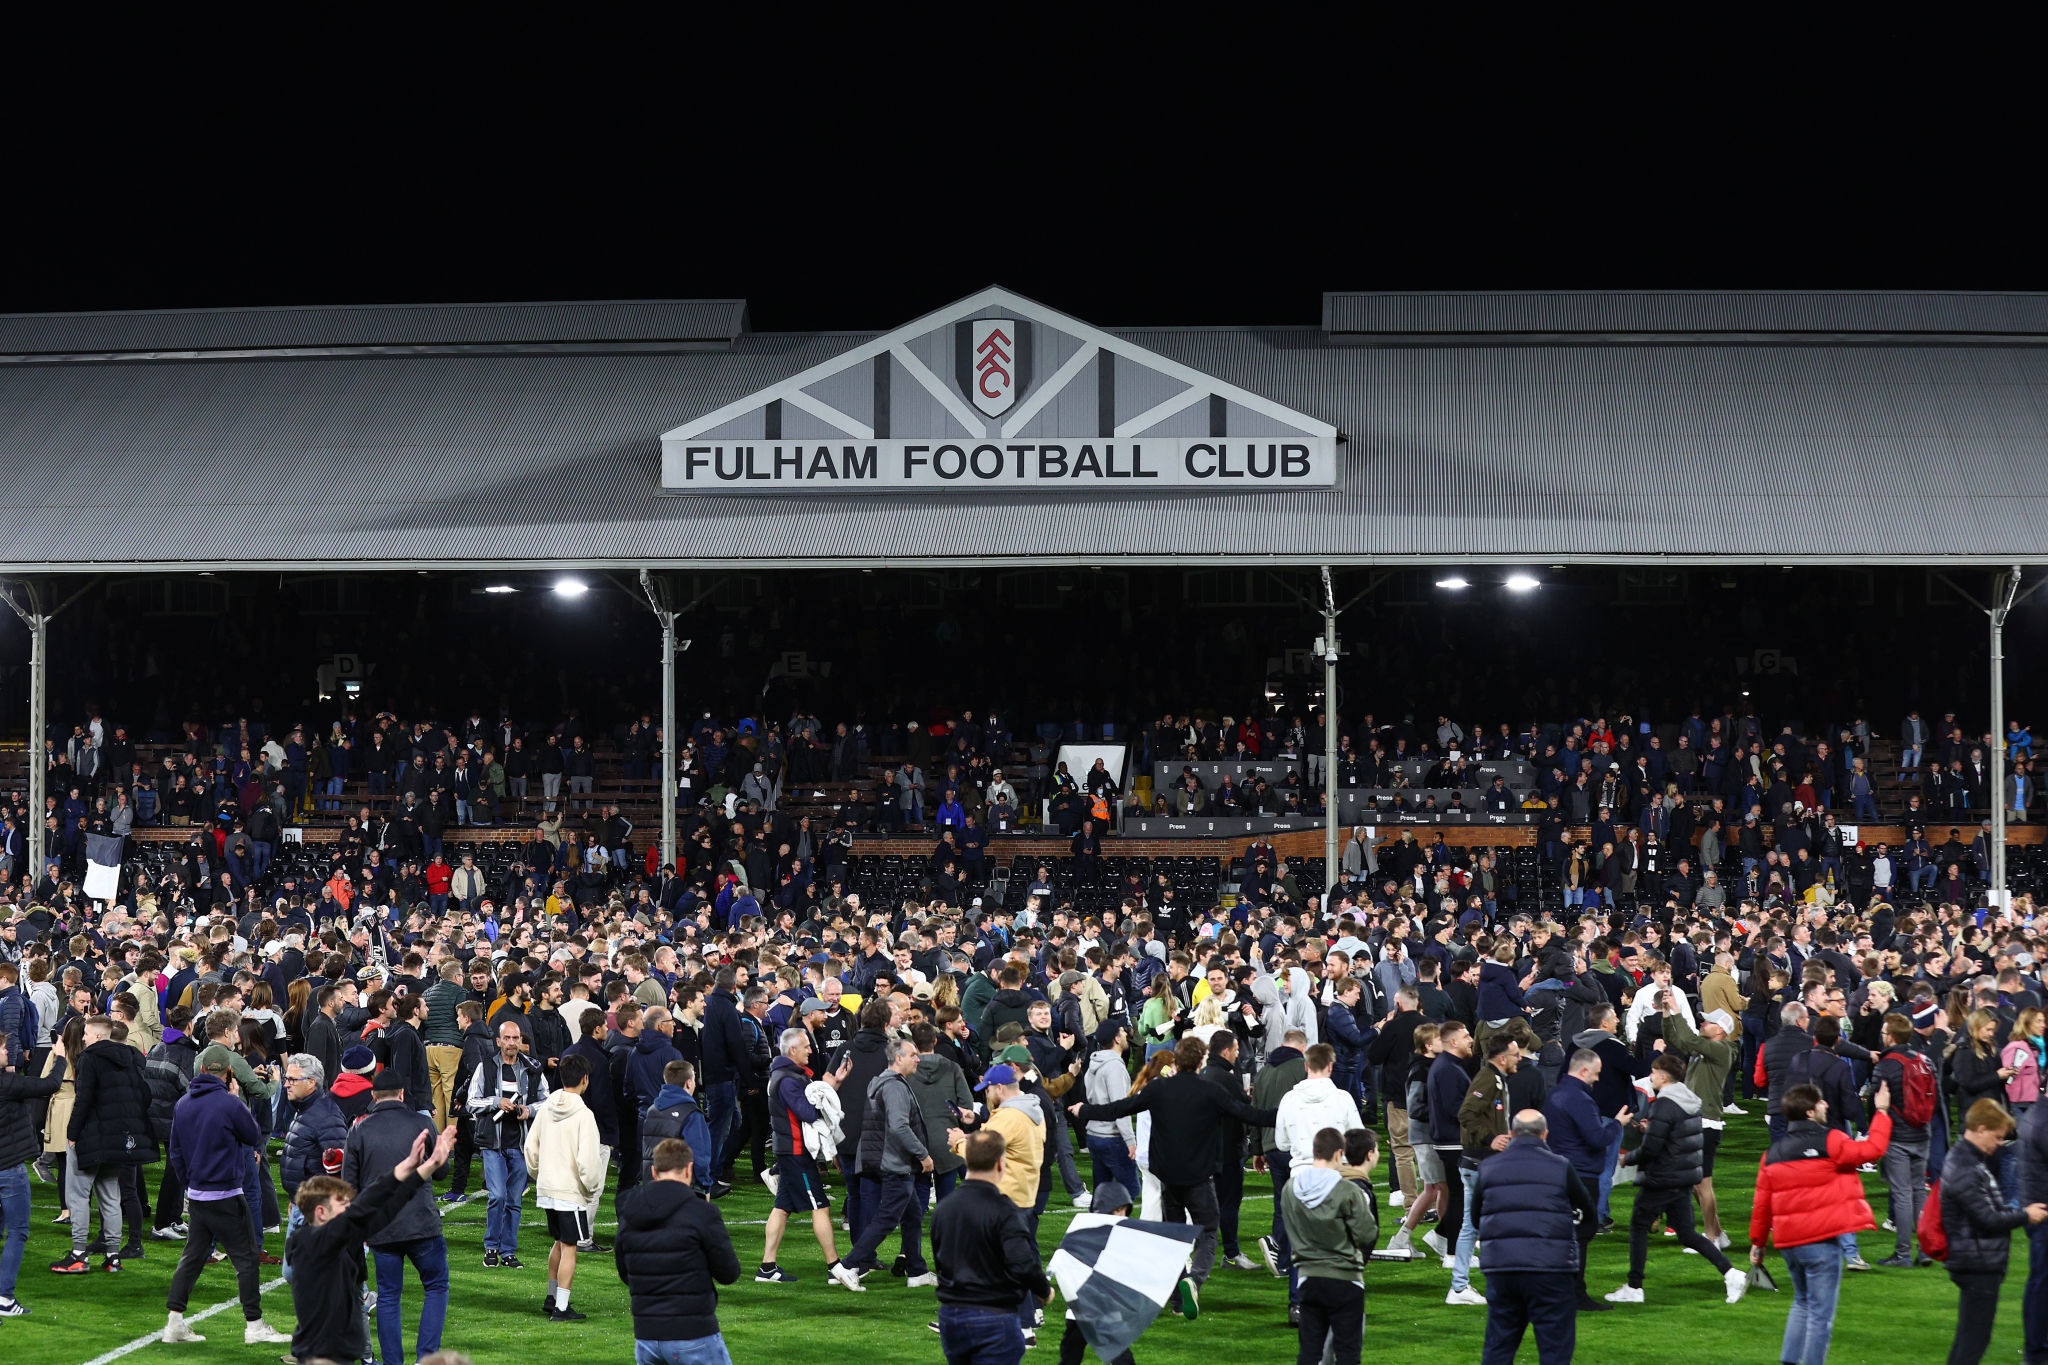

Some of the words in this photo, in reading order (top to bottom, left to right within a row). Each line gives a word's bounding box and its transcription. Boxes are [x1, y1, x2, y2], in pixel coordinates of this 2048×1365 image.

[685, 445, 878, 480] FULHAM
[904, 444, 1158, 479] FOOTBALL
[1185, 443, 1311, 478] CLUB
[339, 656, 354, 673] D
[787, 655, 801, 672] E
[1760, 652, 1776, 670] G
